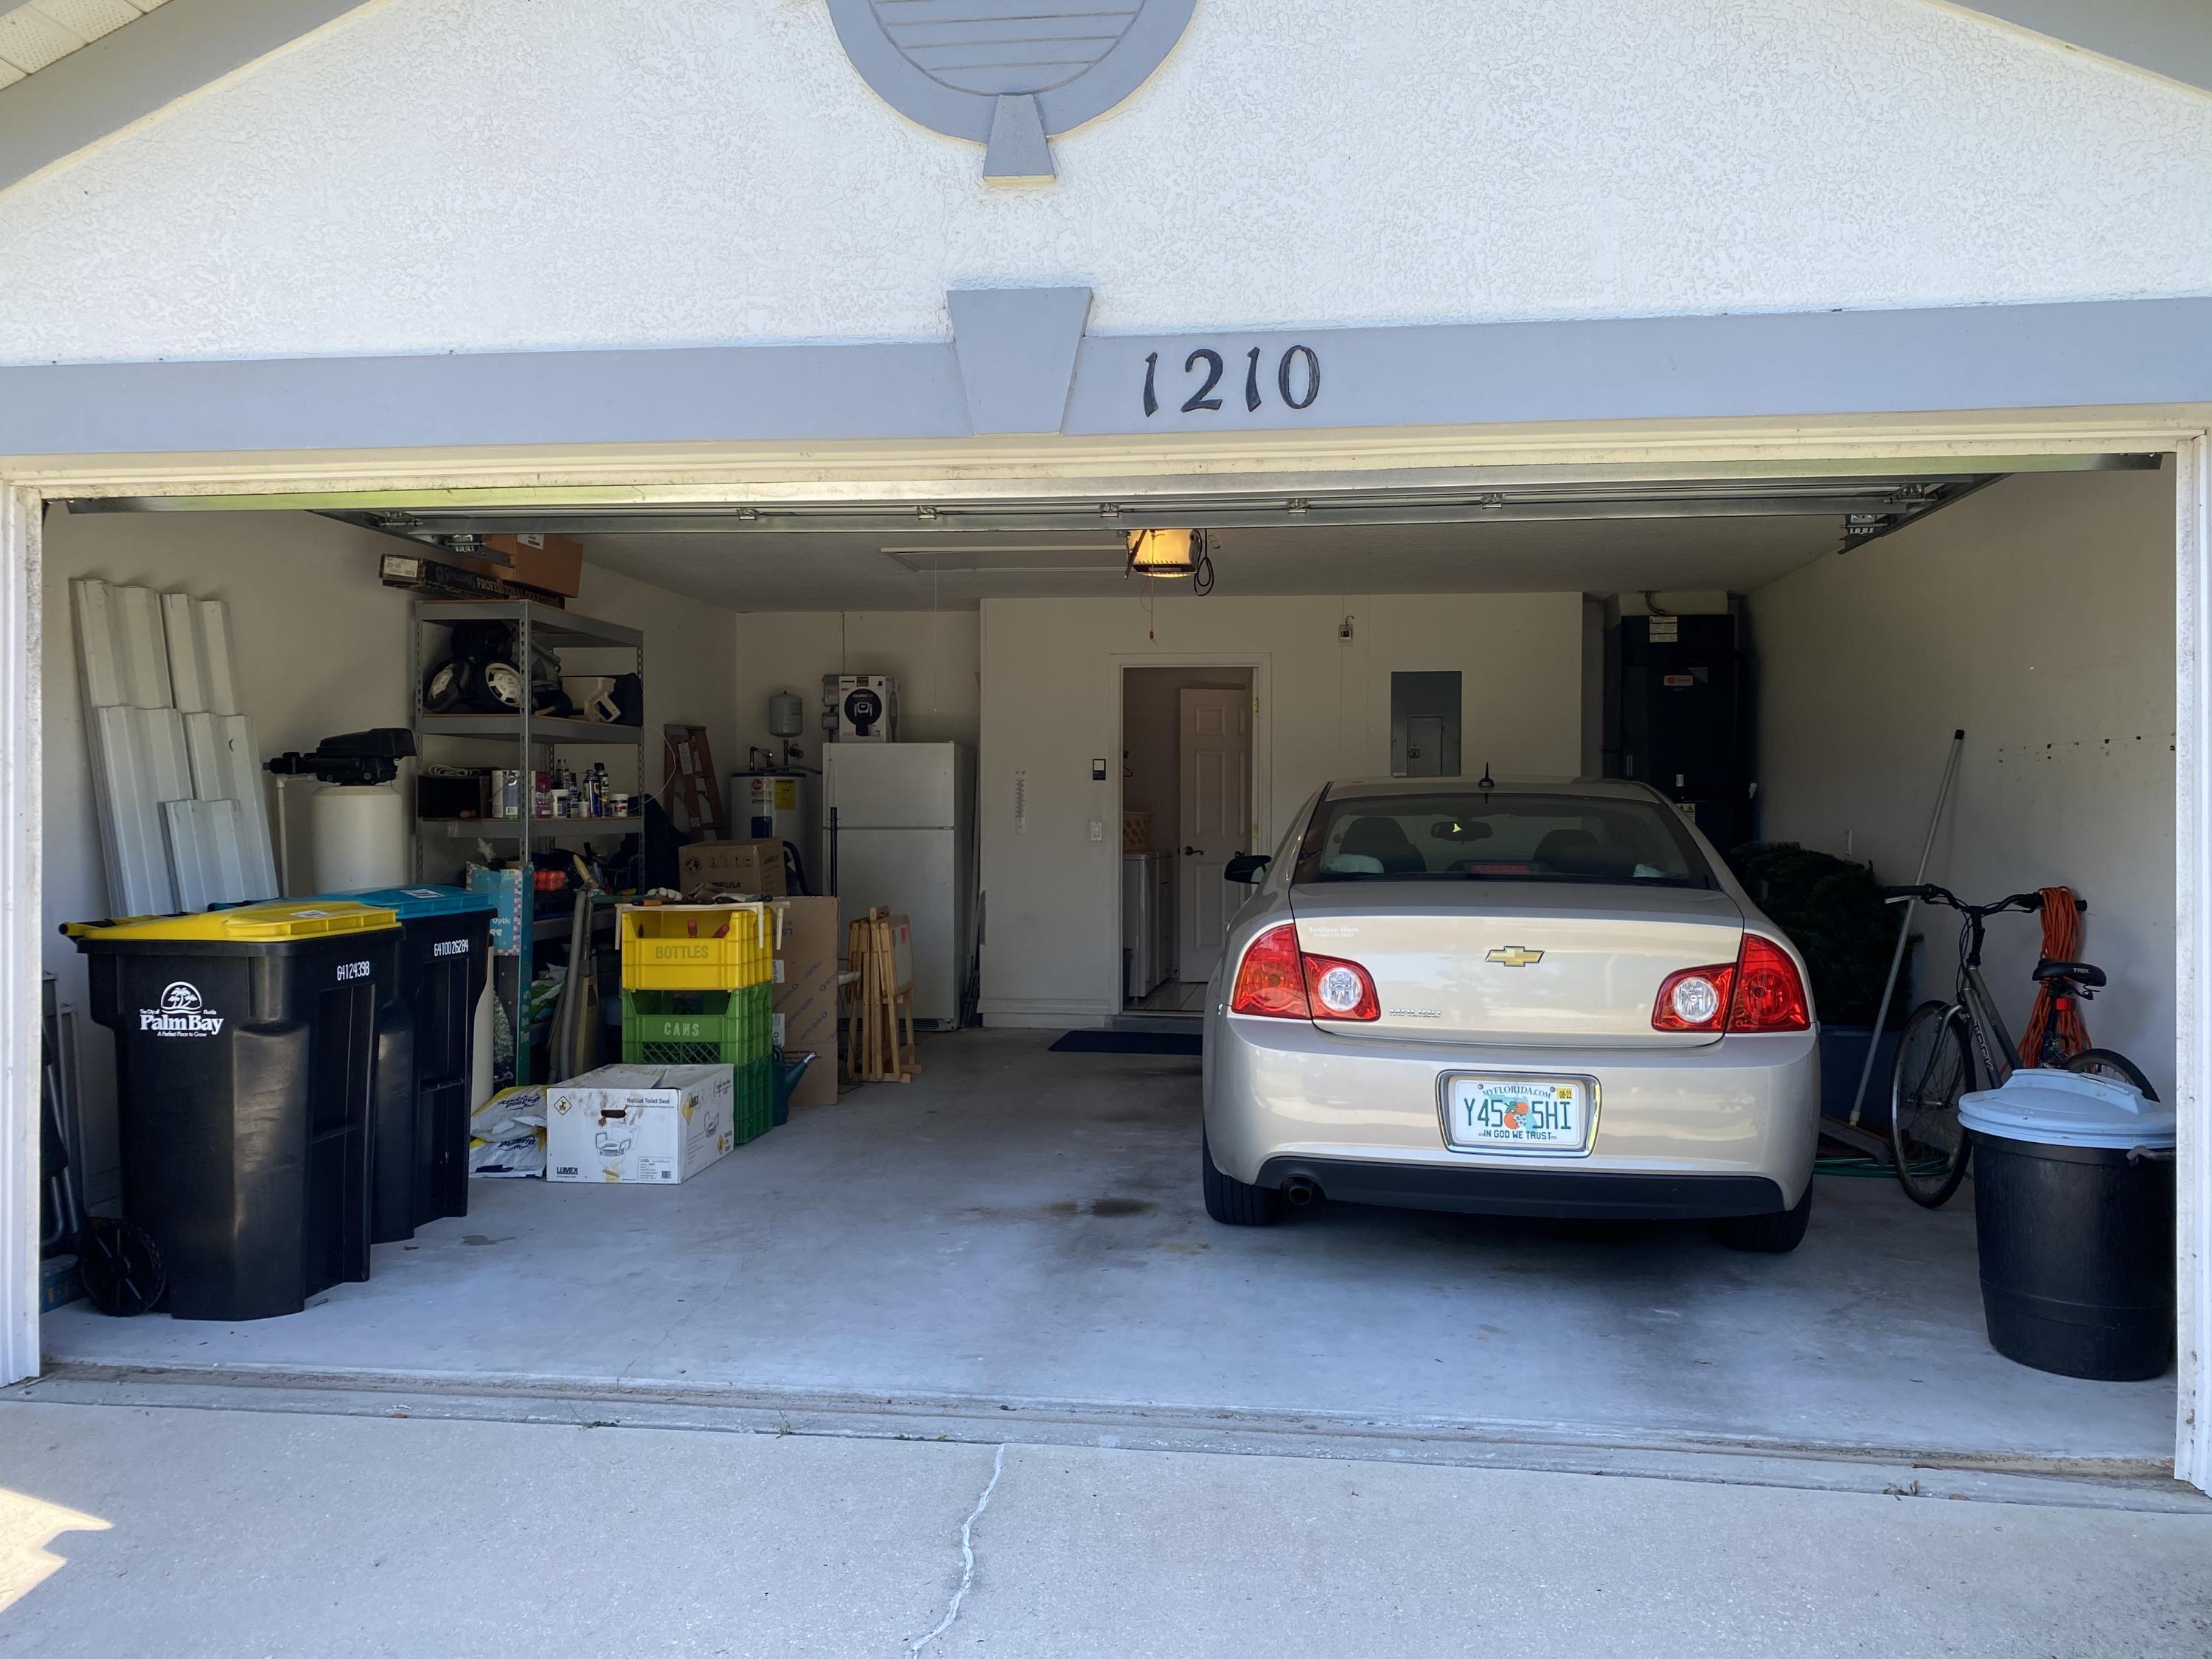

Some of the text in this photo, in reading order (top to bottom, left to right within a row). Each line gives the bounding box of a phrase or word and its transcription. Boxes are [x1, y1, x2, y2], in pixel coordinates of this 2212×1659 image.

[1143, 344, 1320, 417] 1210
[492, 917, 511, 926] Optic
[434, 939, 469, 957] 6410026284
[655, 945, 709, 959] BOTTLES
[337, 961, 369, 981] 64124398
[139, 1015, 224, 1035] Palm Bay
[664, 1022, 700, 1037] CANS
[1482, 1085, 1552, 1099] MYFLORIDA.COM
[1464, 1098, 1503, 1127] Y45
[1484, 1129, 1552, 1140] IN GOD WE TRUST
[557, 1166, 579, 1175] LUMEX
